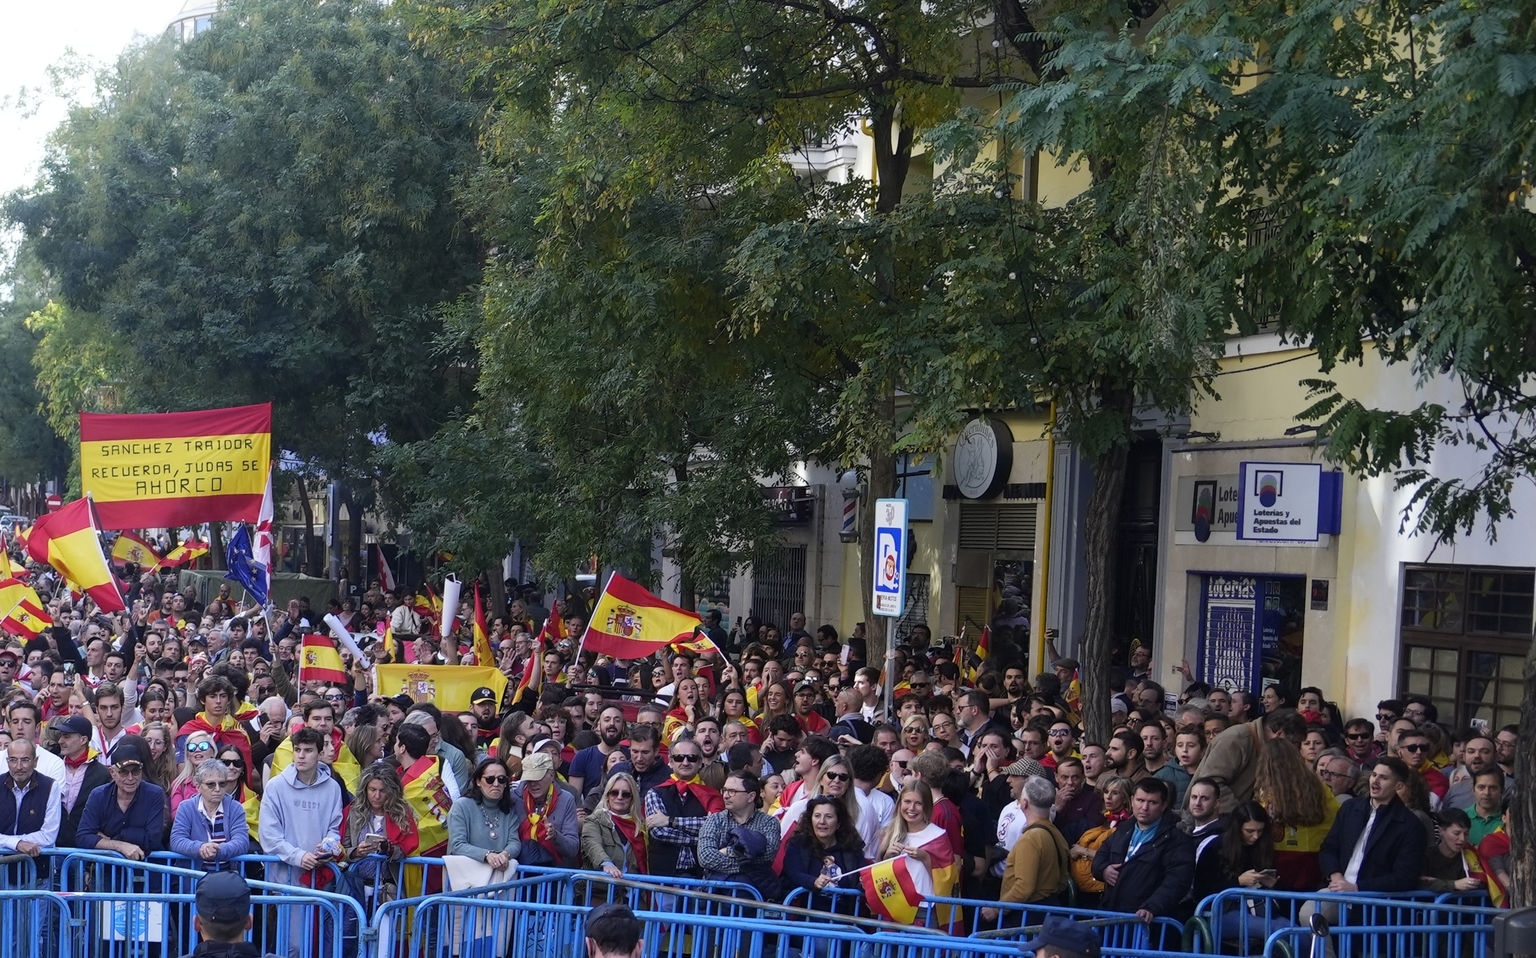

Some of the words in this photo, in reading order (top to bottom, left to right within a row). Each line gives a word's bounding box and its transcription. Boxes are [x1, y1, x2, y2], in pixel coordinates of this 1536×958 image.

[102, 442, 173, 456] SANCHEZ
[184, 438, 253, 452] TRAIDOR
[184, 460, 233, 474] JUDAS
[242, 460, 259, 472] SE
[136, 476, 222, 496] AHORCO
[1253, 508, 1284, 516] Loterías
[1285, 510, 1290, 518] y
[1253, 518, 1288, 526] Apuestas
[1290, 518, 1301, 526] del
[1252, 526, 1278, 534] Estado
[350, 585, 357, 594] P
